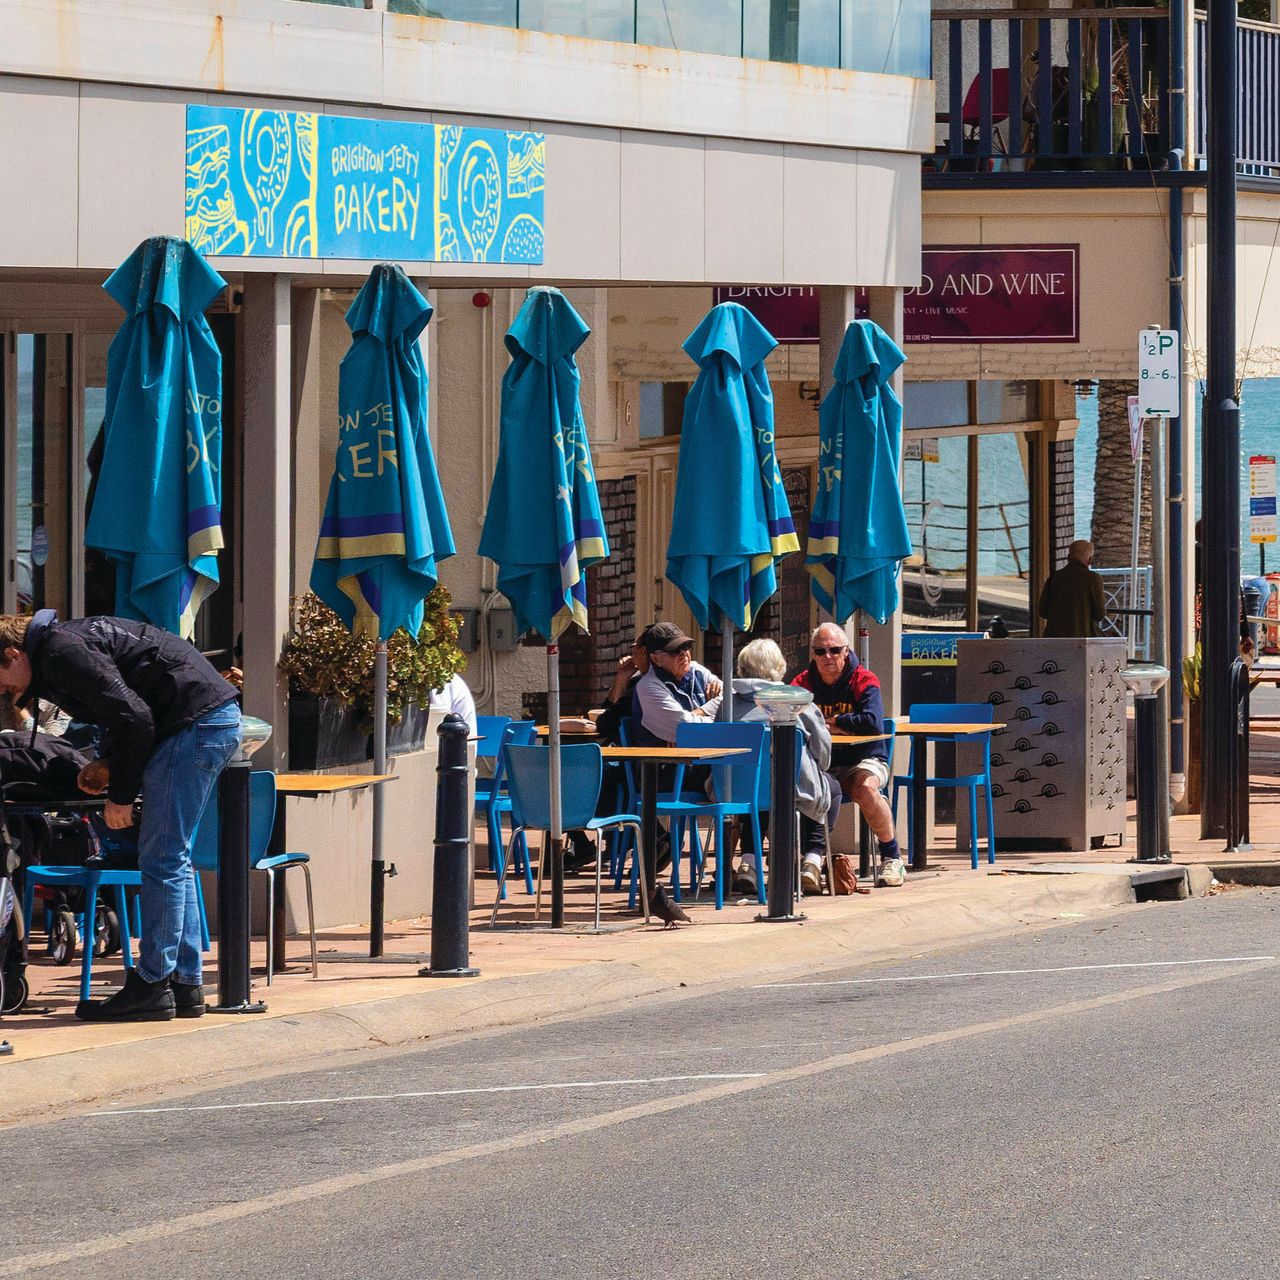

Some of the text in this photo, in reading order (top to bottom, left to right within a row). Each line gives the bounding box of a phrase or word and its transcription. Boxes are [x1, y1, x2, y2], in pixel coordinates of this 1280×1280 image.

[331, 142, 420, 179] BRIGHTON JETTY
[334, 176, 420, 241] BAKERY
[940, 273, 994, 296] AND
[1000, 273, 1066, 296] WINE
[925, 306, 942, 315] LIVE
[945, 306, 968, 315] MUSIC
